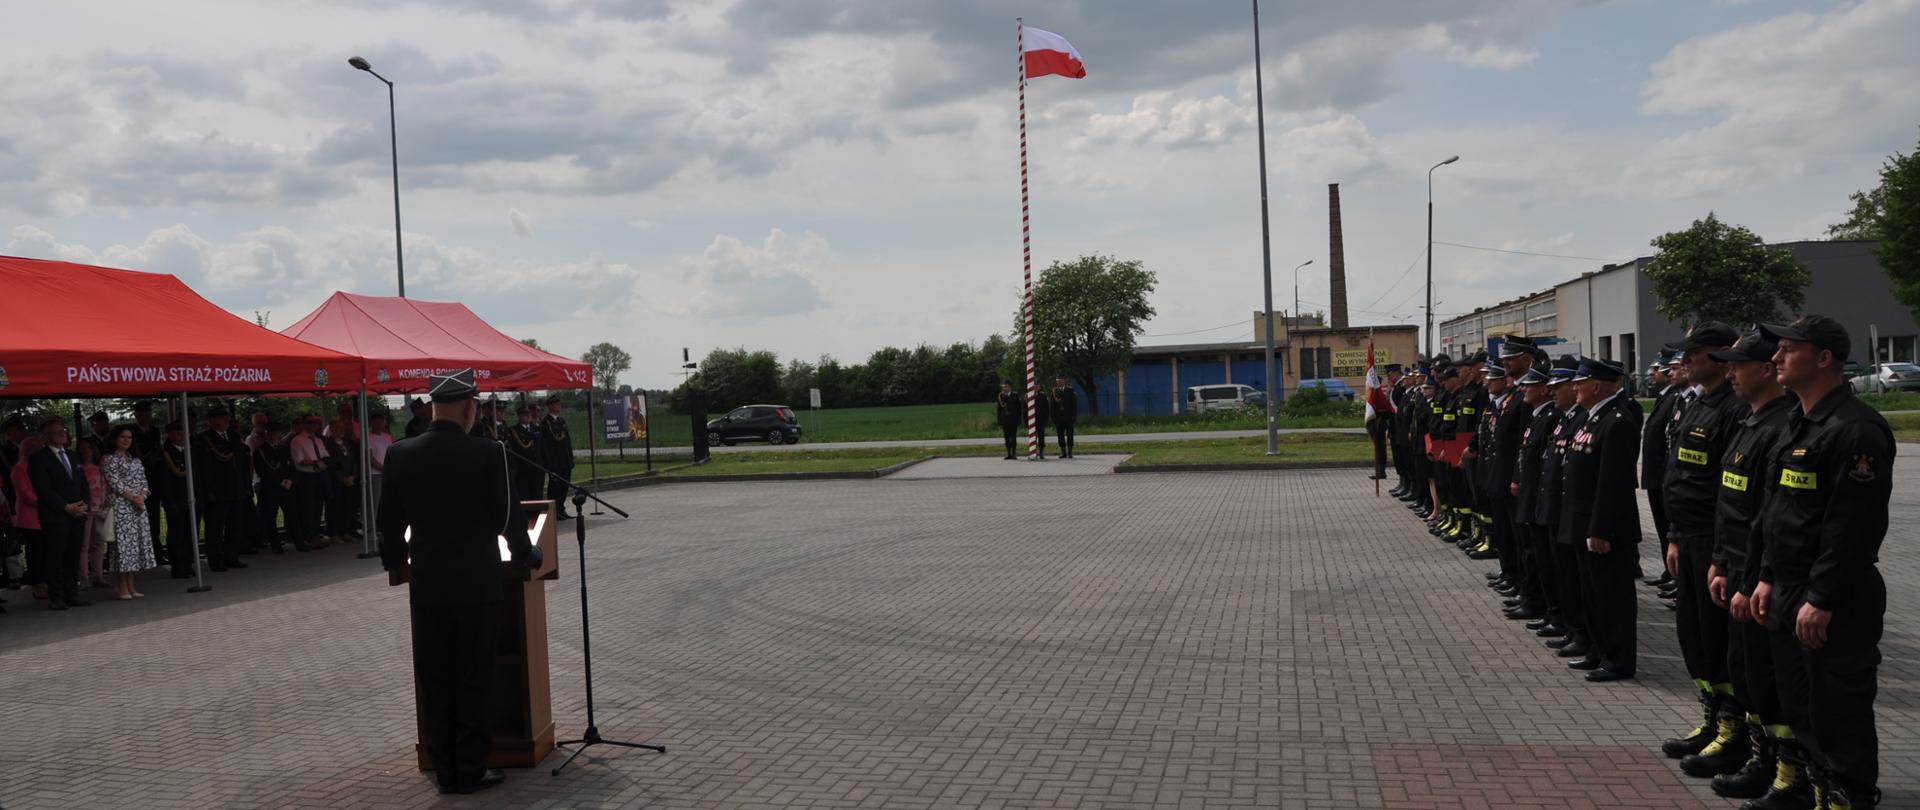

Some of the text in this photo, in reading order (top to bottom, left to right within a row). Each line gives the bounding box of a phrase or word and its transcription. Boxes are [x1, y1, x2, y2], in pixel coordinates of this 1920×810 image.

[67, 363, 272, 382] PAŃSTWOWA STRAŻ POŻARNA
[399, 368, 435, 379] KOMENDA
[478, 369, 491, 379] PSP
[574, 369, 587, 383] 112
